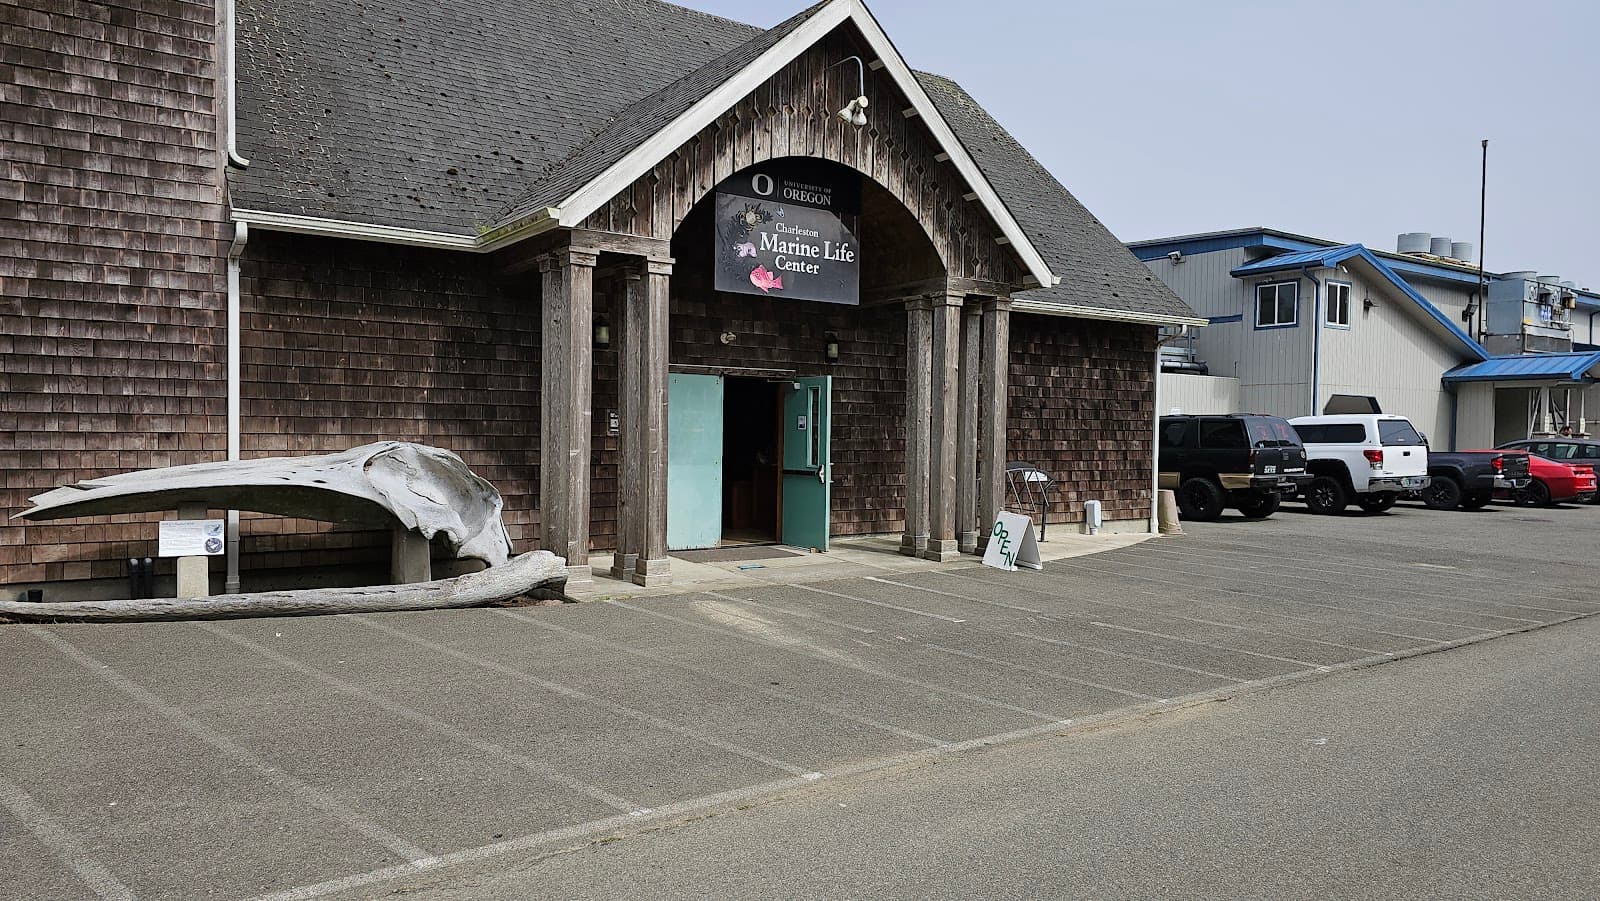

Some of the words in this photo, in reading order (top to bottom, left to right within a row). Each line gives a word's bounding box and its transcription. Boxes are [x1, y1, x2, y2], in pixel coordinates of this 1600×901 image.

[784, 180, 822, 192] UNIVERSITY
[783, 187, 832, 206] OREGON
[775, 222, 819, 238] Charleston
[760, 231, 820, 258] Marine
[823, 240, 855, 263] Life
[775, 255, 820, 274] Center
[993, 521, 1016, 567] OPEN
